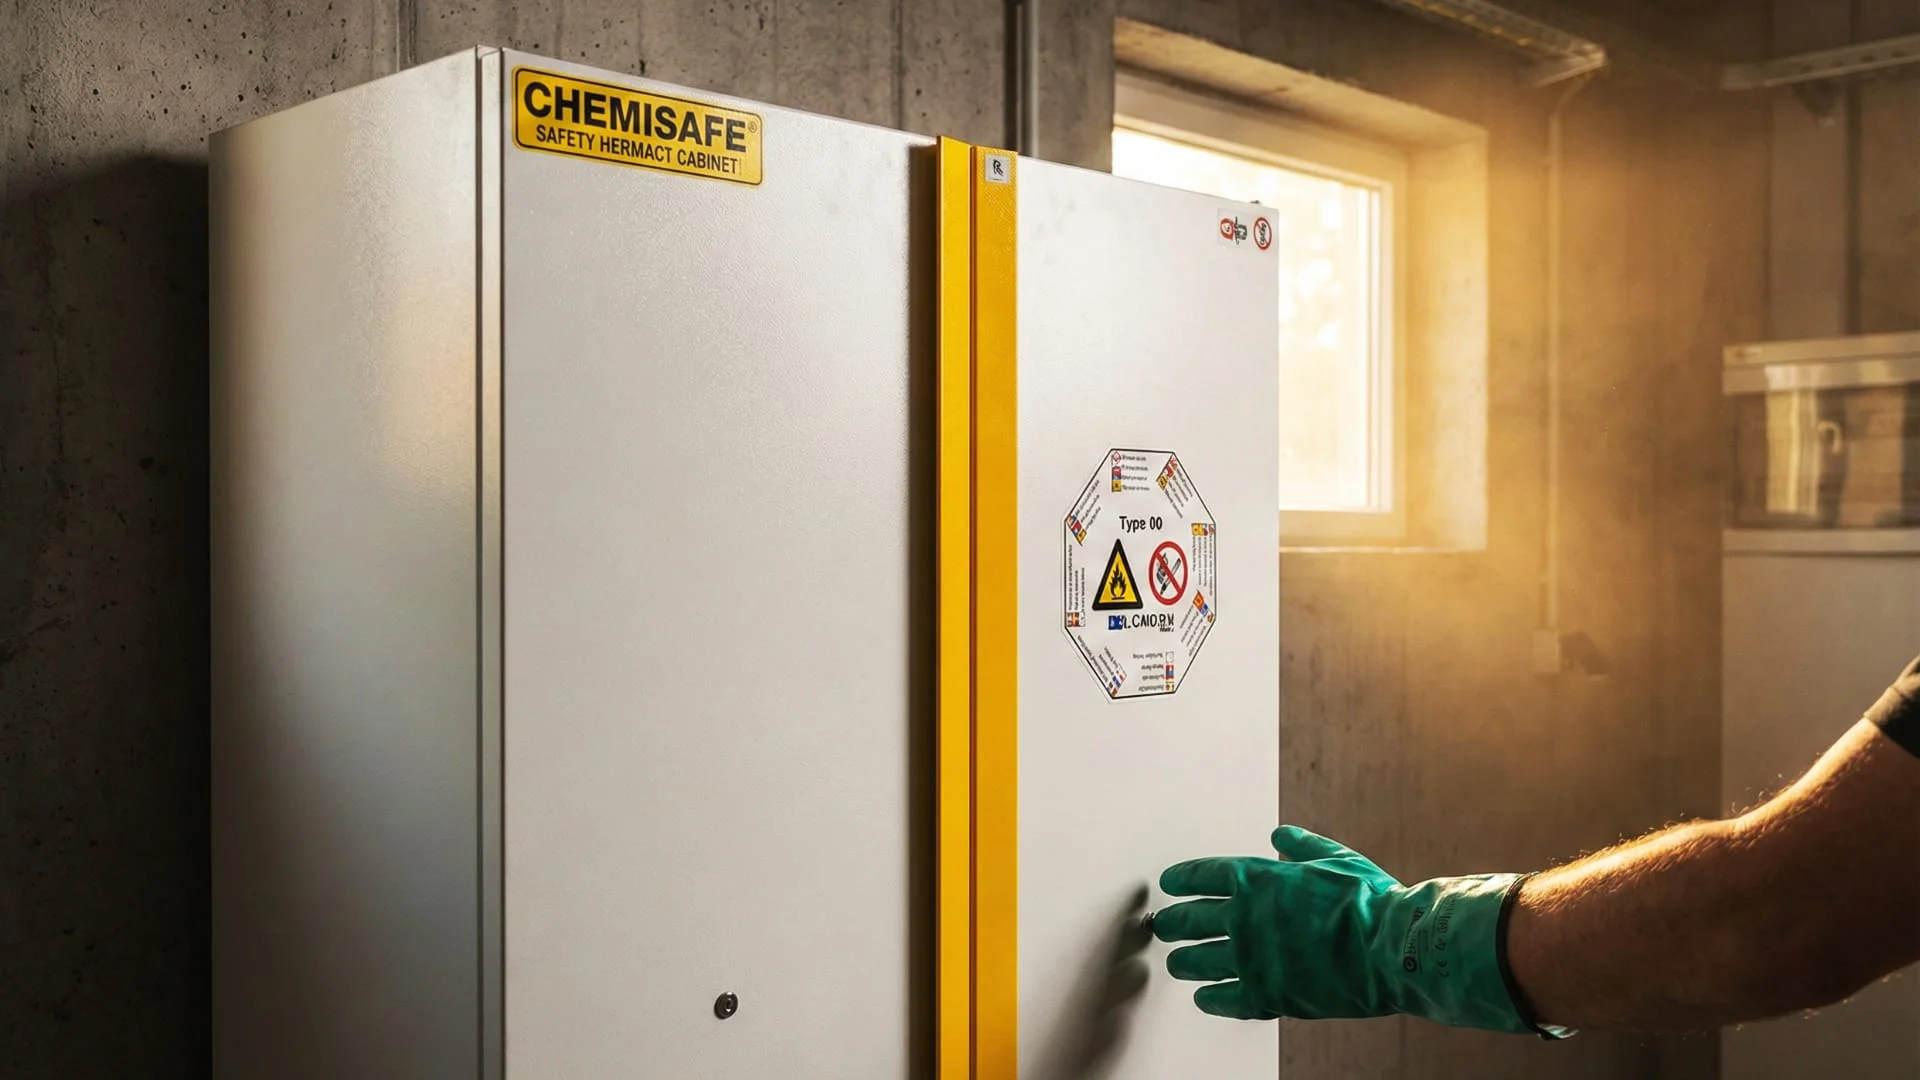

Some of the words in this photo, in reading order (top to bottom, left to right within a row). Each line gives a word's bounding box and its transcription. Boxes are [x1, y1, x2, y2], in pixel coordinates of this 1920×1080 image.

[536, 124, 595, 150] SAFETY
[600, 135, 672, 163] HERMACT
[677, 149, 738, 175] CABINET
